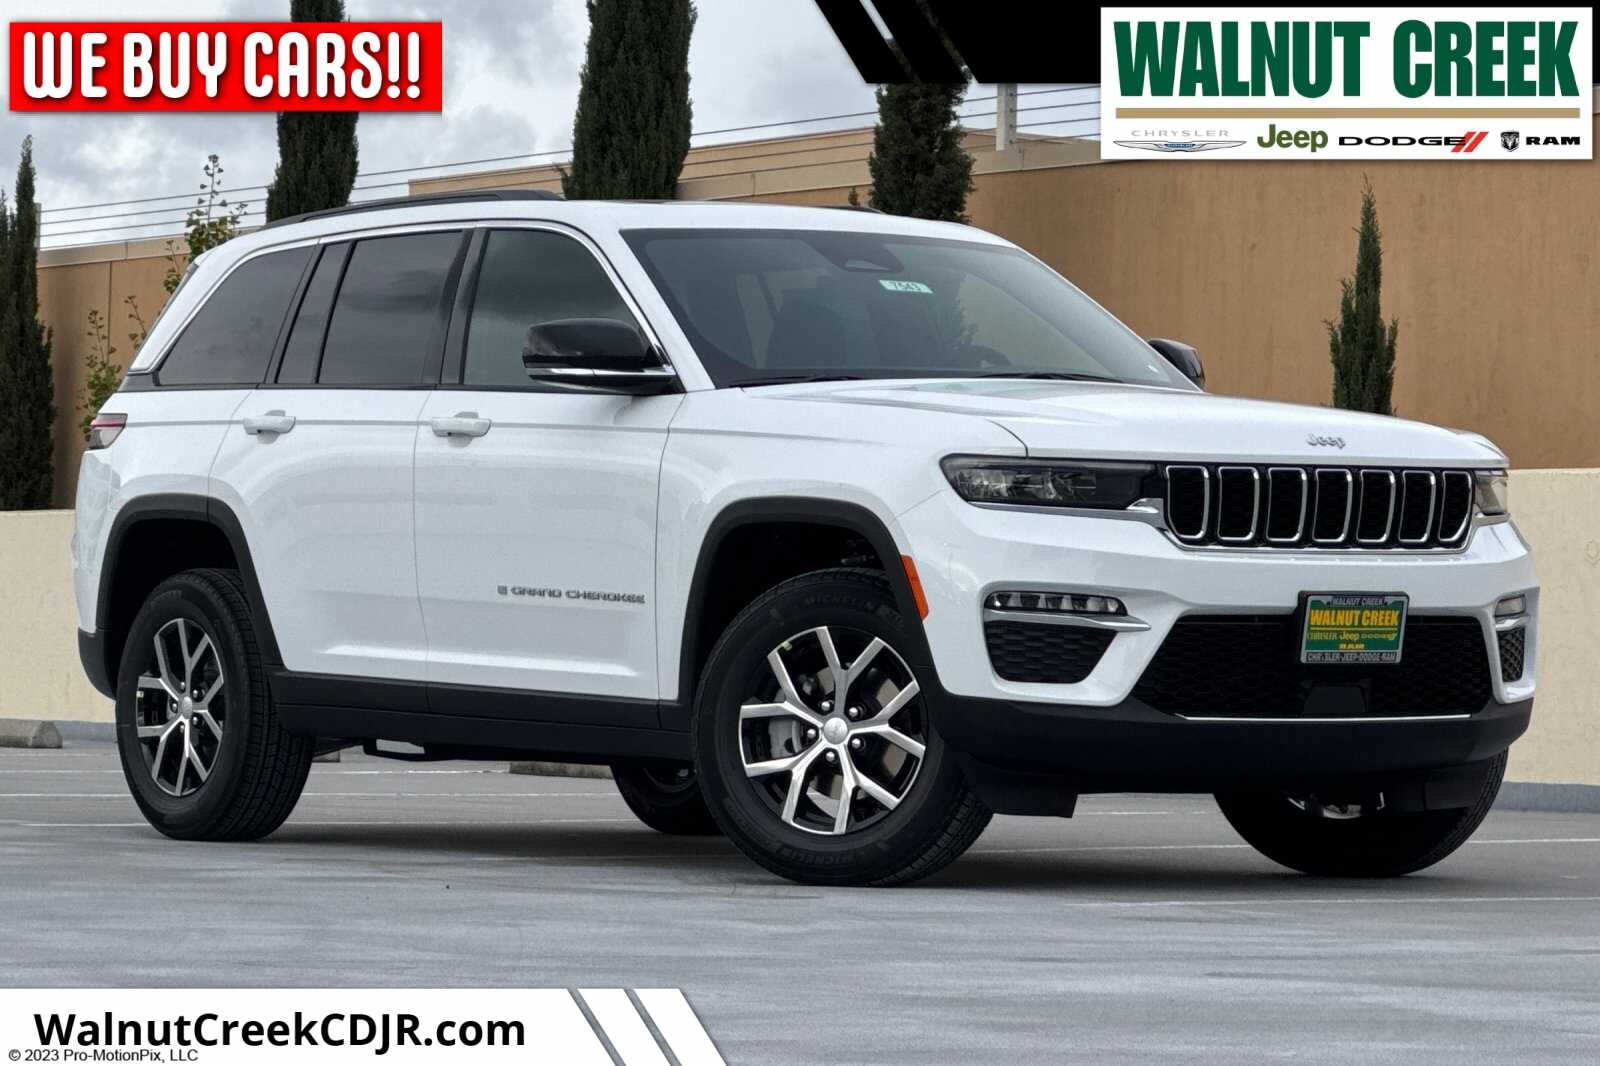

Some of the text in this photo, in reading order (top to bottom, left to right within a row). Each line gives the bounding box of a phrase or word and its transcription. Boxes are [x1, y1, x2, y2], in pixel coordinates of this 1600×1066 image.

[1305, 433, 1346, 450] Jeep
[510, 586, 645, 604] GRAND CHEROKEE
[1310, 609, 1399, 626] WALNUT CREEK
[1339, 630, 1360, 642] Jeep
